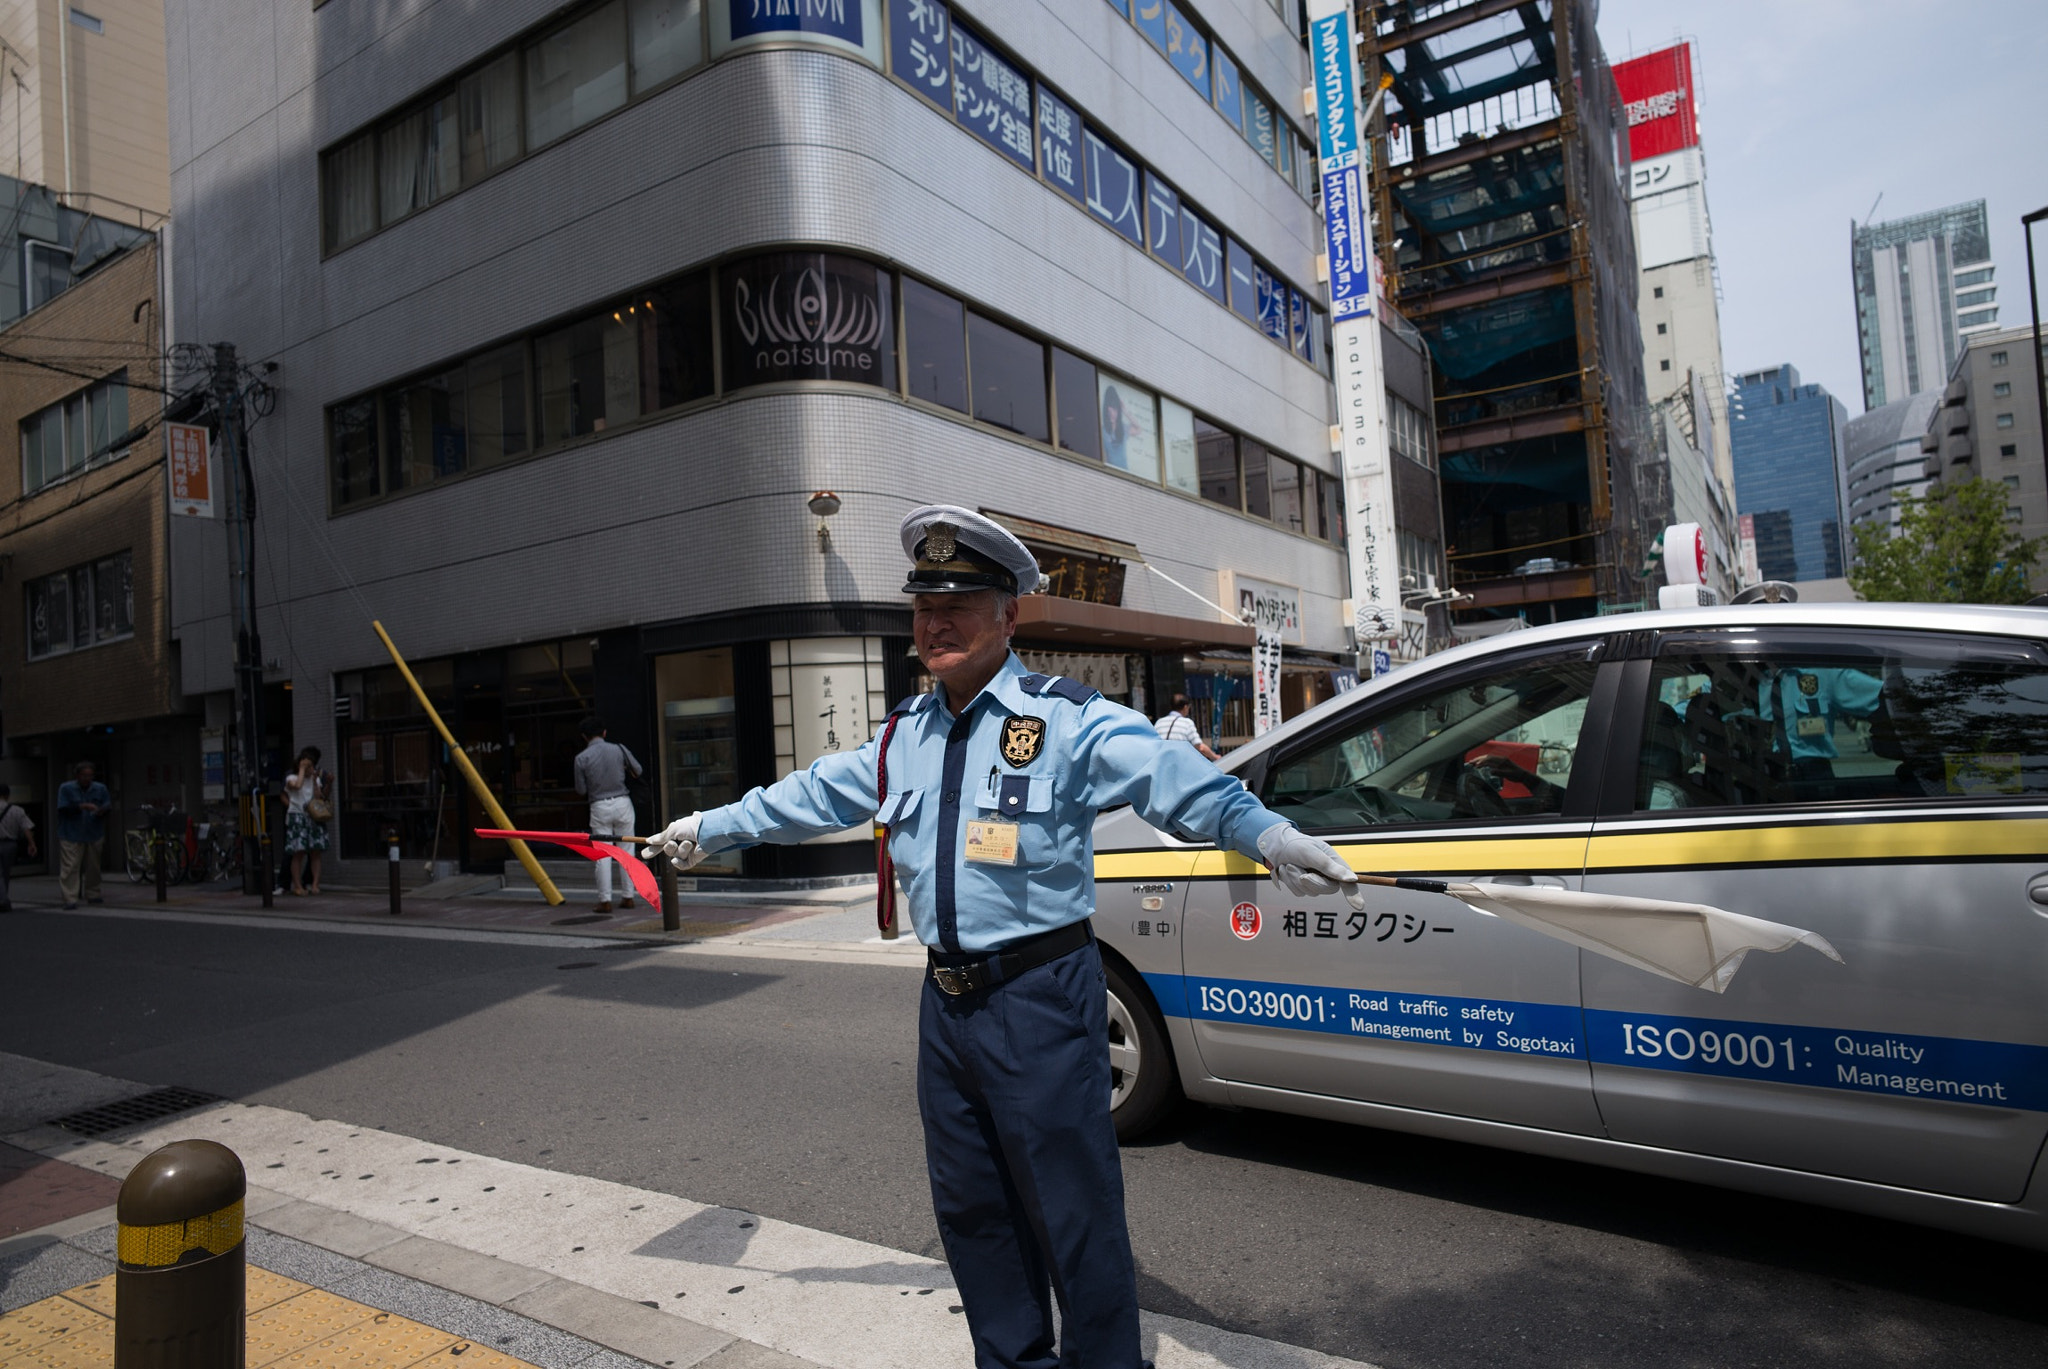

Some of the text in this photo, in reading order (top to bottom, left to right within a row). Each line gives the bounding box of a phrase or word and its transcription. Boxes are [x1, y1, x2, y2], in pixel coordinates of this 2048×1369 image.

[1320, 17, 1348, 155] プライスコンタクト
[910, 38, 1074, 187] ランキング全国1位
[1327, 152, 1354, 170] 4F
[1327, 173, 1352, 299] エステ・ステーション
[1338, 295, 1366, 315] 3F
[756, 344, 873, 371] natsume
[1348, 336, 1367, 446] natsume
[1282, 909, 1455, 943] 相互タクシー
[1200, 986, 1337, 1023] ISO39001:
[1349, 994, 1515, 1026] Road traffic safety
[1350, 1017, 1576, 1055] Management by Sogotaxi
[1621, 1023, 1814, 1072] ISO9001:
[1834, 1036, 1925, 1064] Quality
[1836, 1064, 2008, 1100] Management
